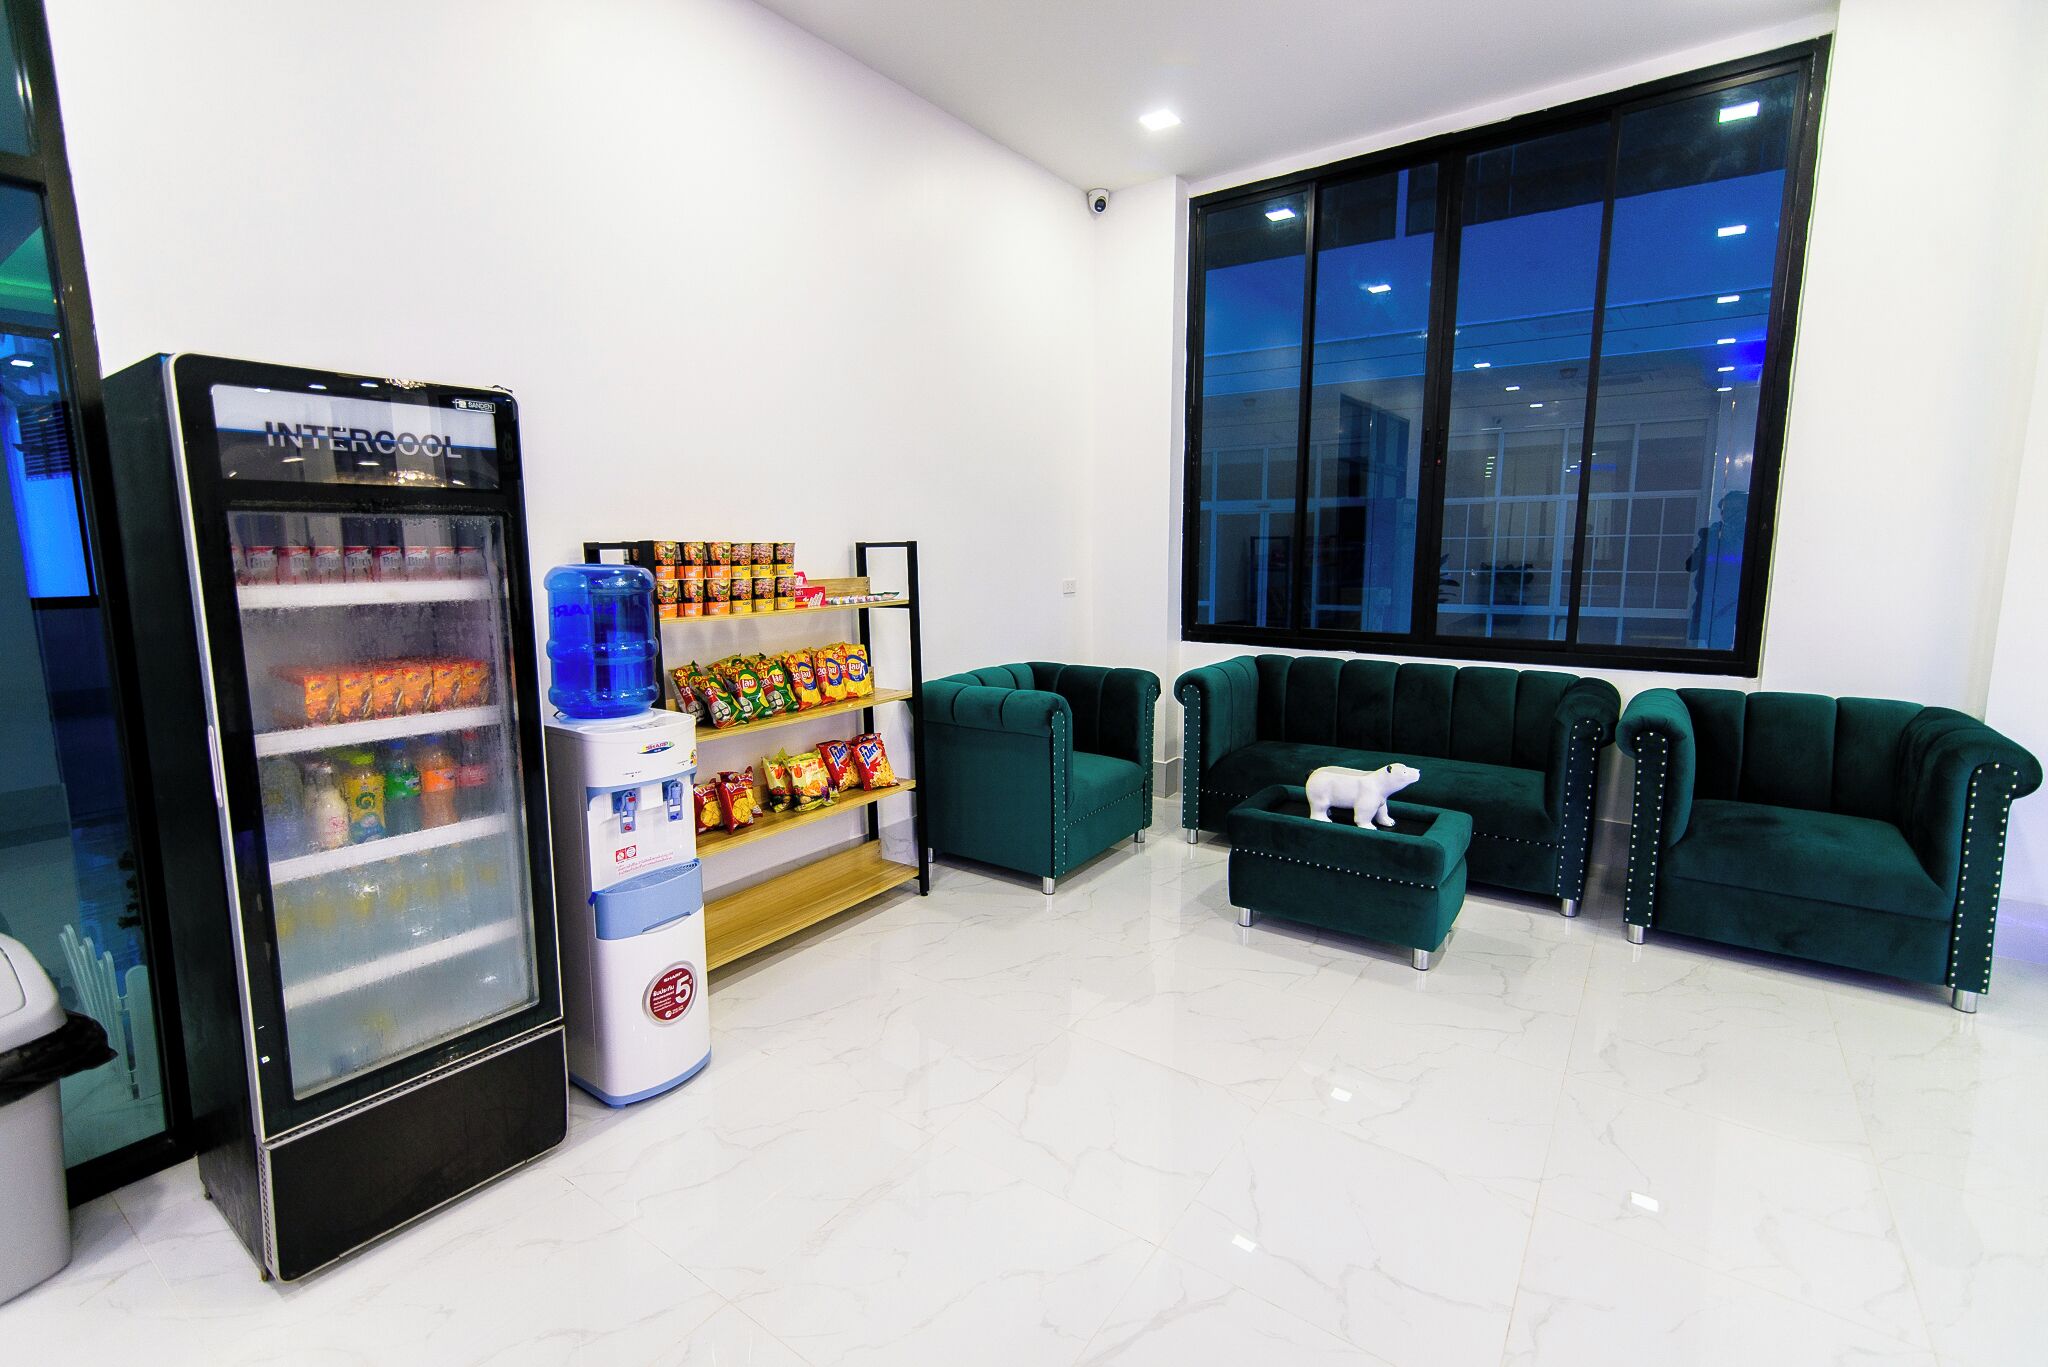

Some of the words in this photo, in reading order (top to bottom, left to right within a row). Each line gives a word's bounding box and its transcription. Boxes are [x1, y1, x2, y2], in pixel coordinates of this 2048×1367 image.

[265, 421, 462, 459] INTERCOOL
[645, 741, 669, 751] SHARP
[675, 974, 690, 1004] 5
